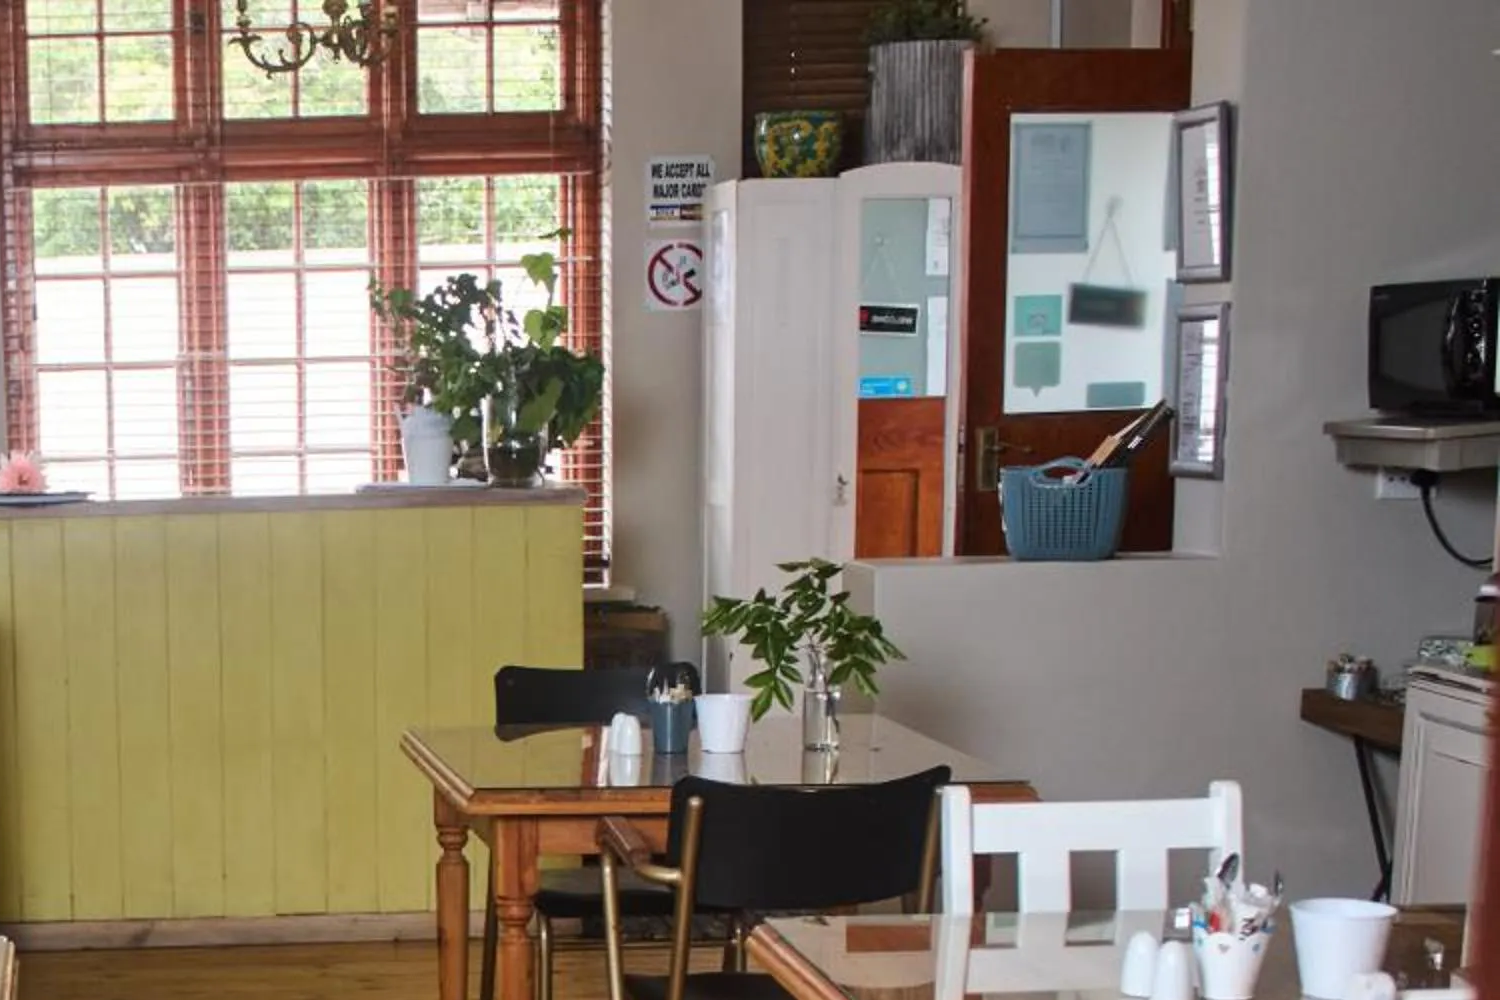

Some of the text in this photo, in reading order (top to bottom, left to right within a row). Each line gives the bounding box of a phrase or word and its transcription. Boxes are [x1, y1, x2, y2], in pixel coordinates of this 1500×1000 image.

[651, 162, 710, 178] WE ACCEPT ALL
[653, 183, 679, 199] MAJOR
